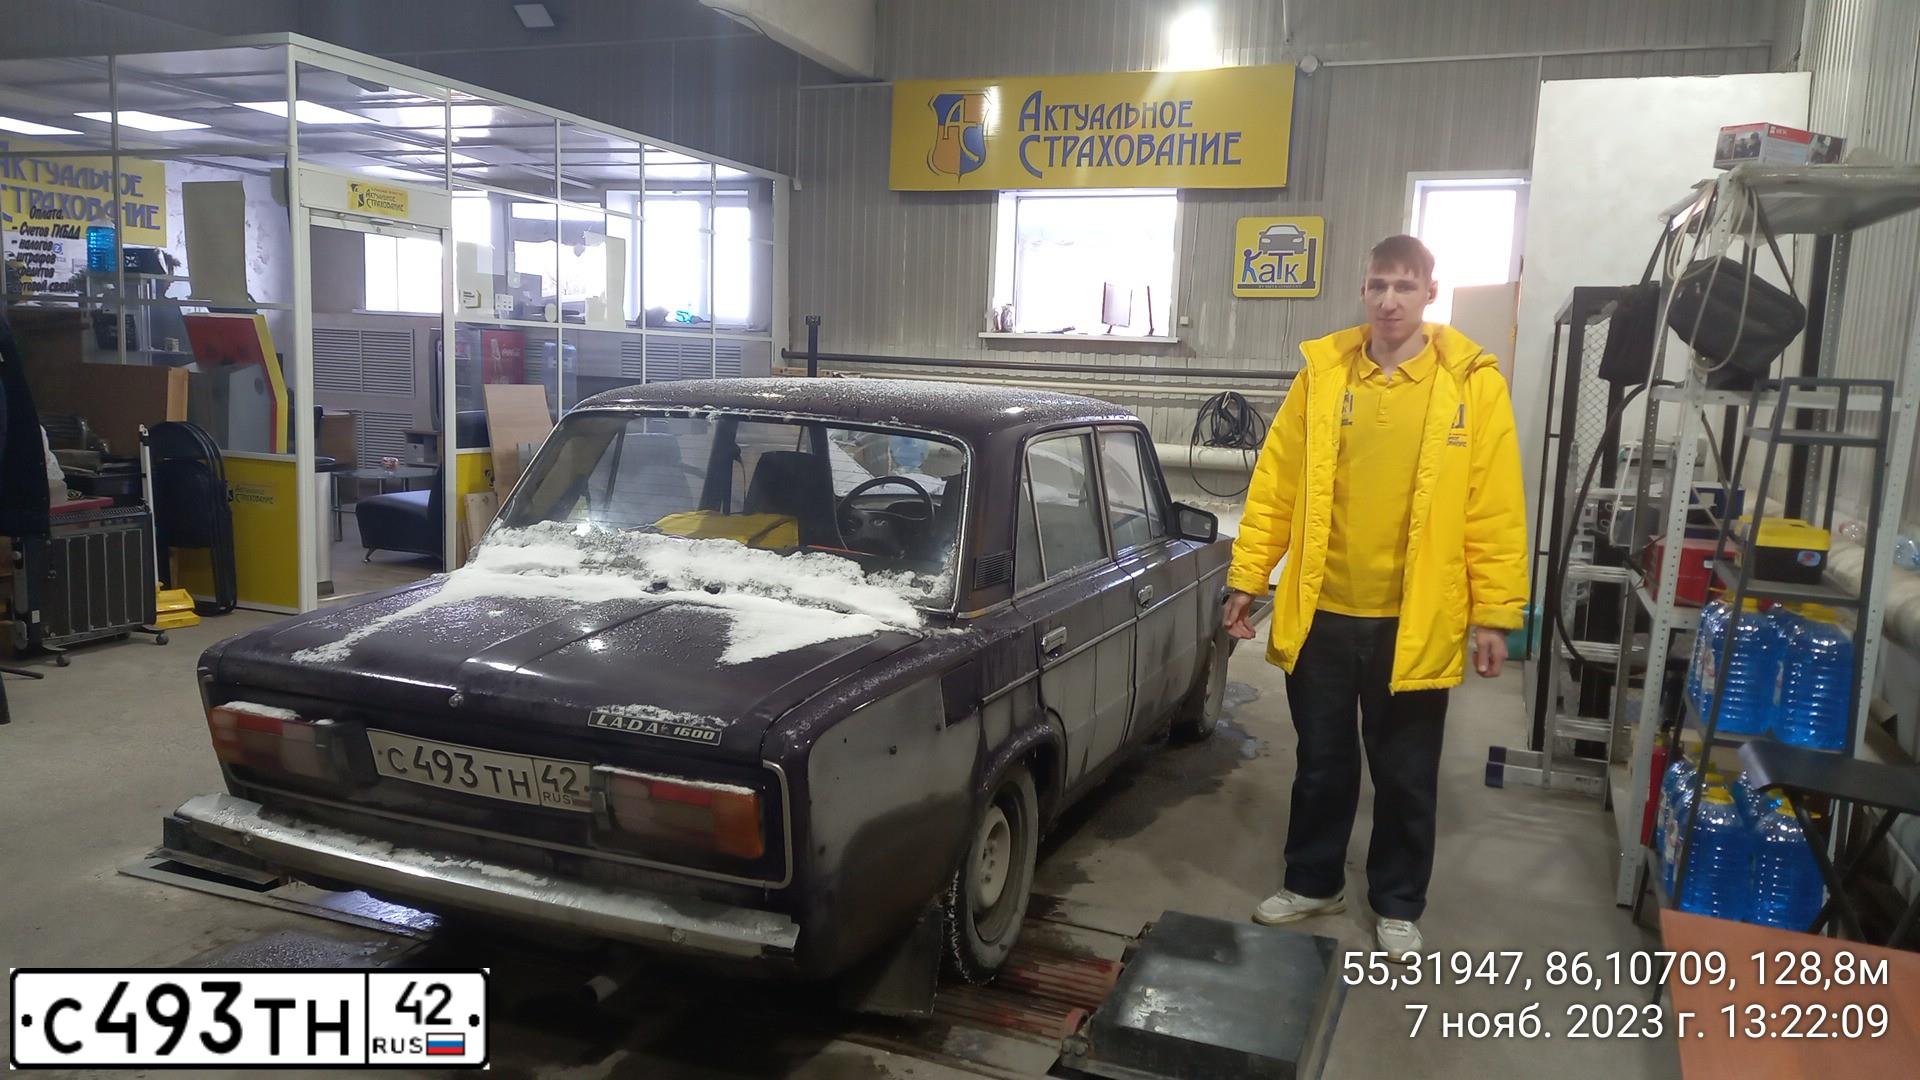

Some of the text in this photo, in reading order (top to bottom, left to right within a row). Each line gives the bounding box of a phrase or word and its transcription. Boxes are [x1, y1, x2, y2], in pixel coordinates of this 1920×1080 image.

[1018, 90, 1193, 131] АКТУАЛЬНОЕ
[1019, 132, 1242, 179] СТРАХОВАНИЕ
[0, 183, 161, 231] ТРАХОВНИЕ
[596, 713, 716, 741] LADA 1600
[541, 764, 580, 796] 42
[542, 791, 572, 805] RUS
